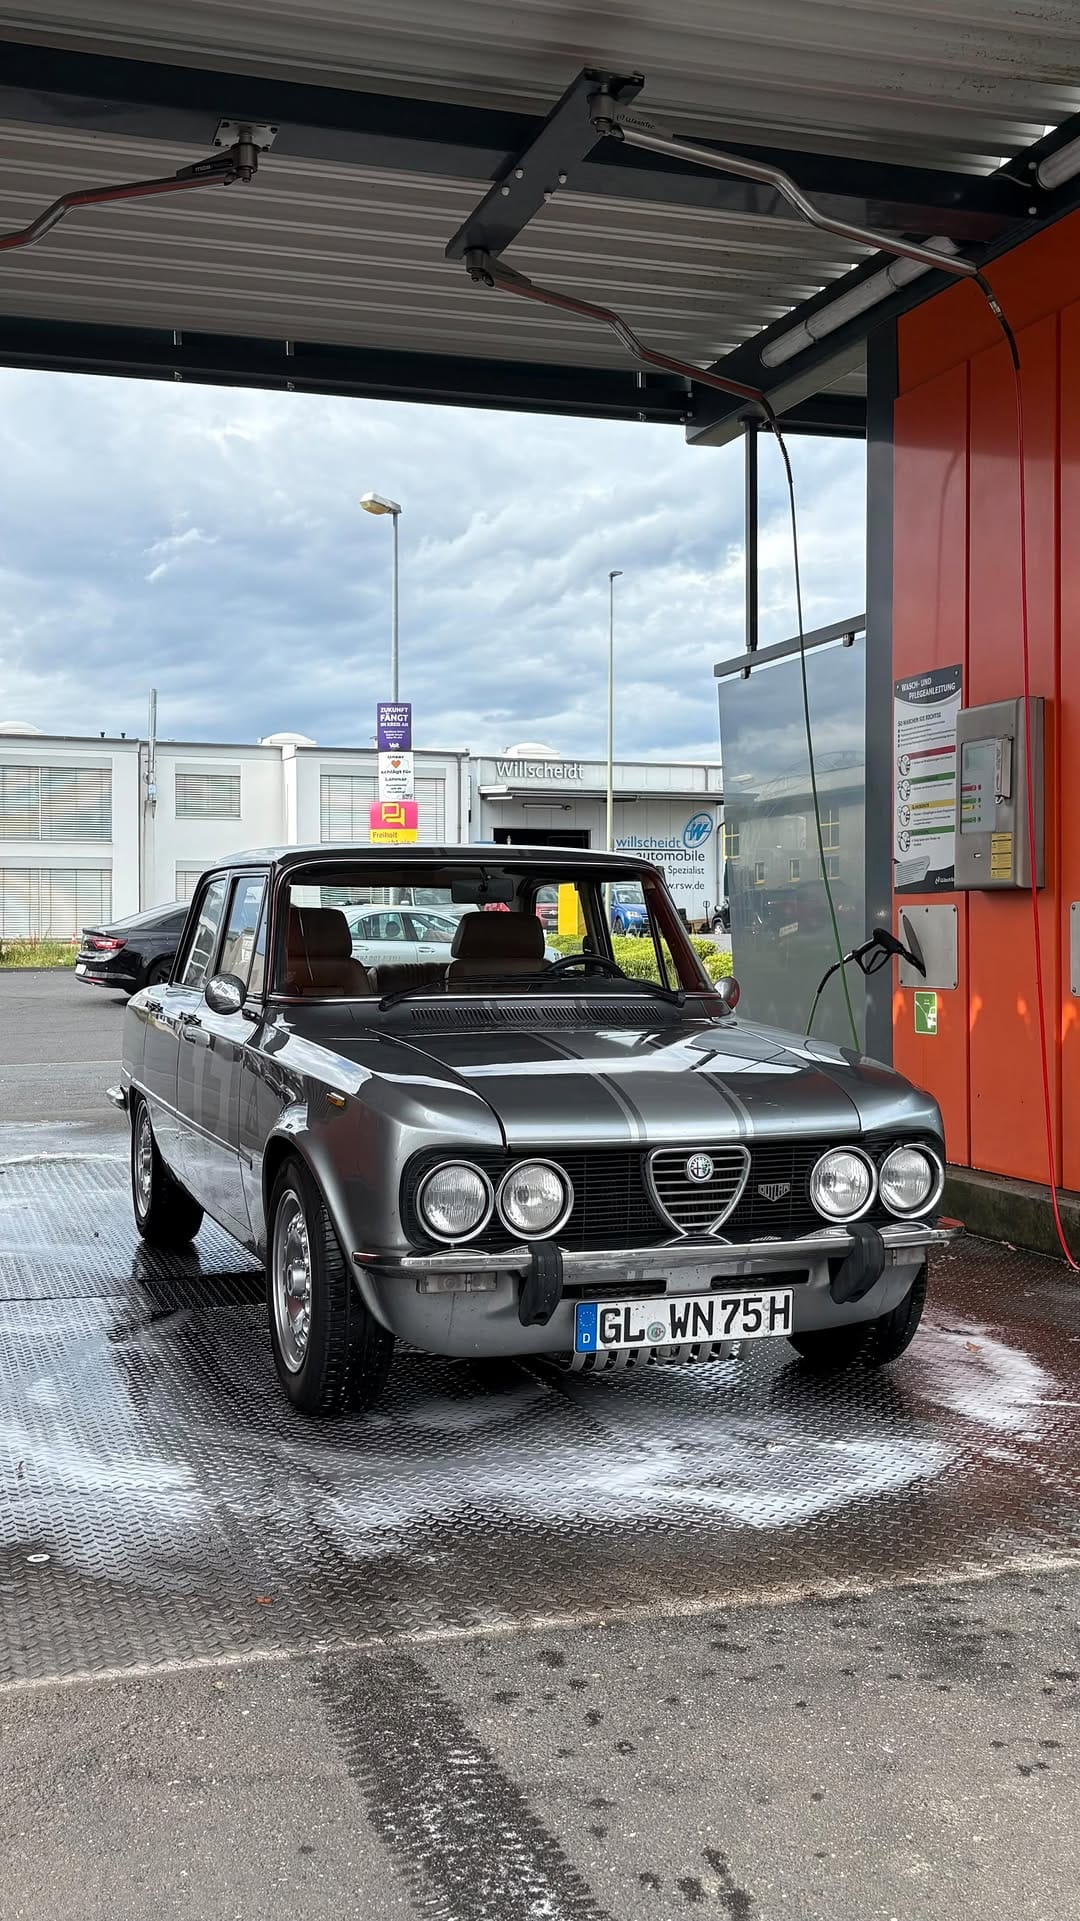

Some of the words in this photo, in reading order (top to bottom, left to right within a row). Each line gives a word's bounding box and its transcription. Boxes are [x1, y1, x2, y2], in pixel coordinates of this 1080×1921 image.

[901, 680, 920, 692] WASCH-
[920, 677, 932, 687] UND
[908, 682, 956, 700] PFLEGEANLEITUNG
[380, 713, 409, 721] FÄNGT
[496, 761, 585, 780] Willscheidt
[616, 836, 681, 848] willscheidt
[636, 850, 705, 862] automobile
[667, 864, 705, 877] Spezialist
[582, 1333, 591, 1344] D
[599, 1307, 646, 1345] GL
